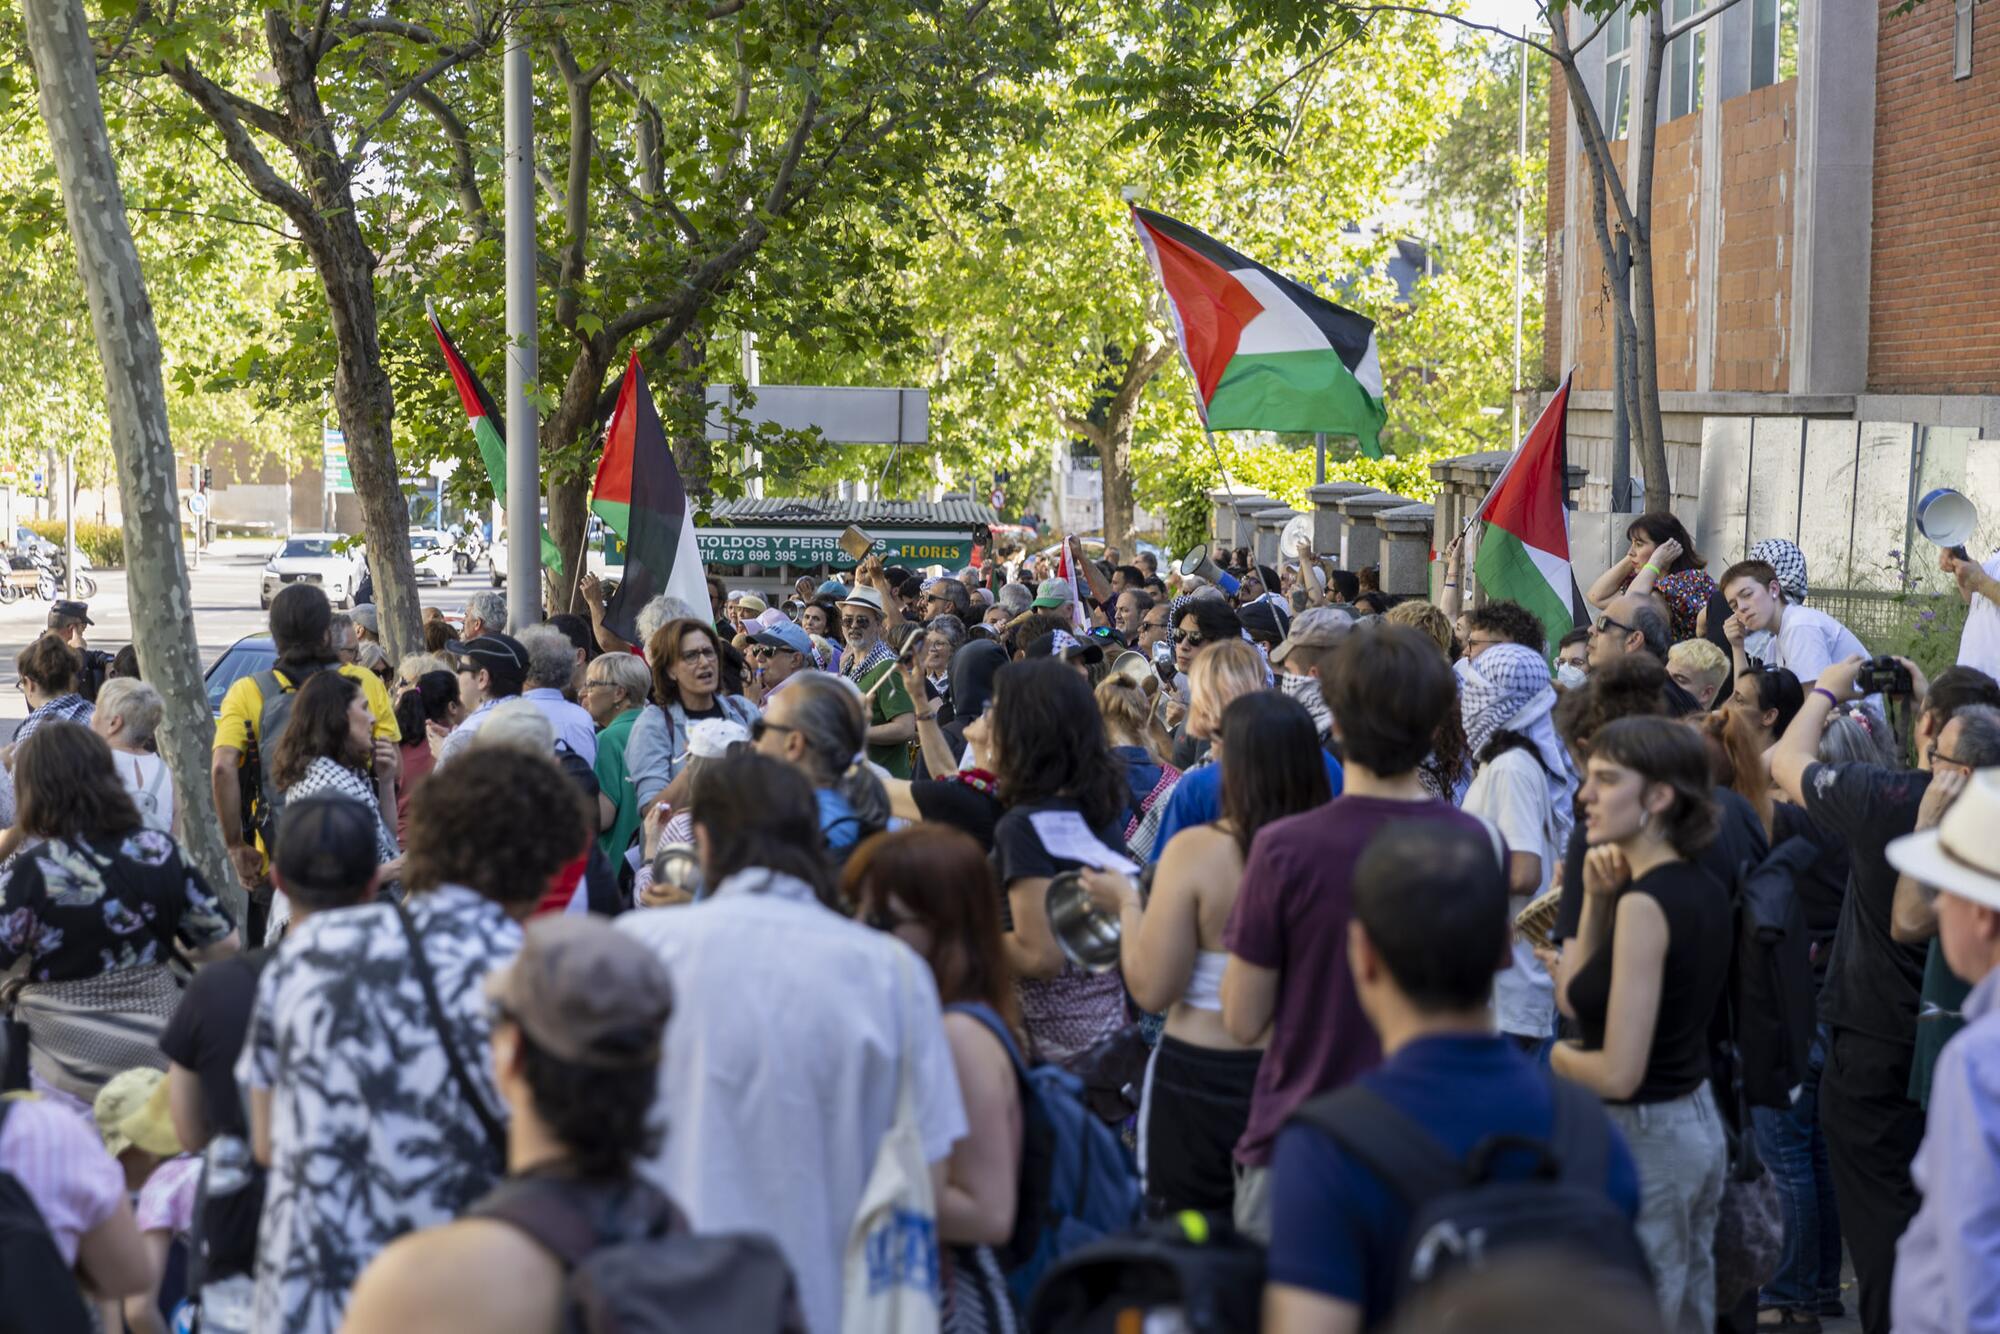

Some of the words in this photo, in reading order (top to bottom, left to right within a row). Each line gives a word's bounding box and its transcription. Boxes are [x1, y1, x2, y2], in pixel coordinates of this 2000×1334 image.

[697, 536, 767, 548] TOLDOS
[772, 537, 784, 548] Y
[789, 537, 887, 550] PERSIS
[722, 549, 745, 561] 673
[748, 550, 771, 561] 696
[774, 550, 797, 561] 395
[811, 551, 833, 562] 918
[901, 544, 960, 559] FLORES
